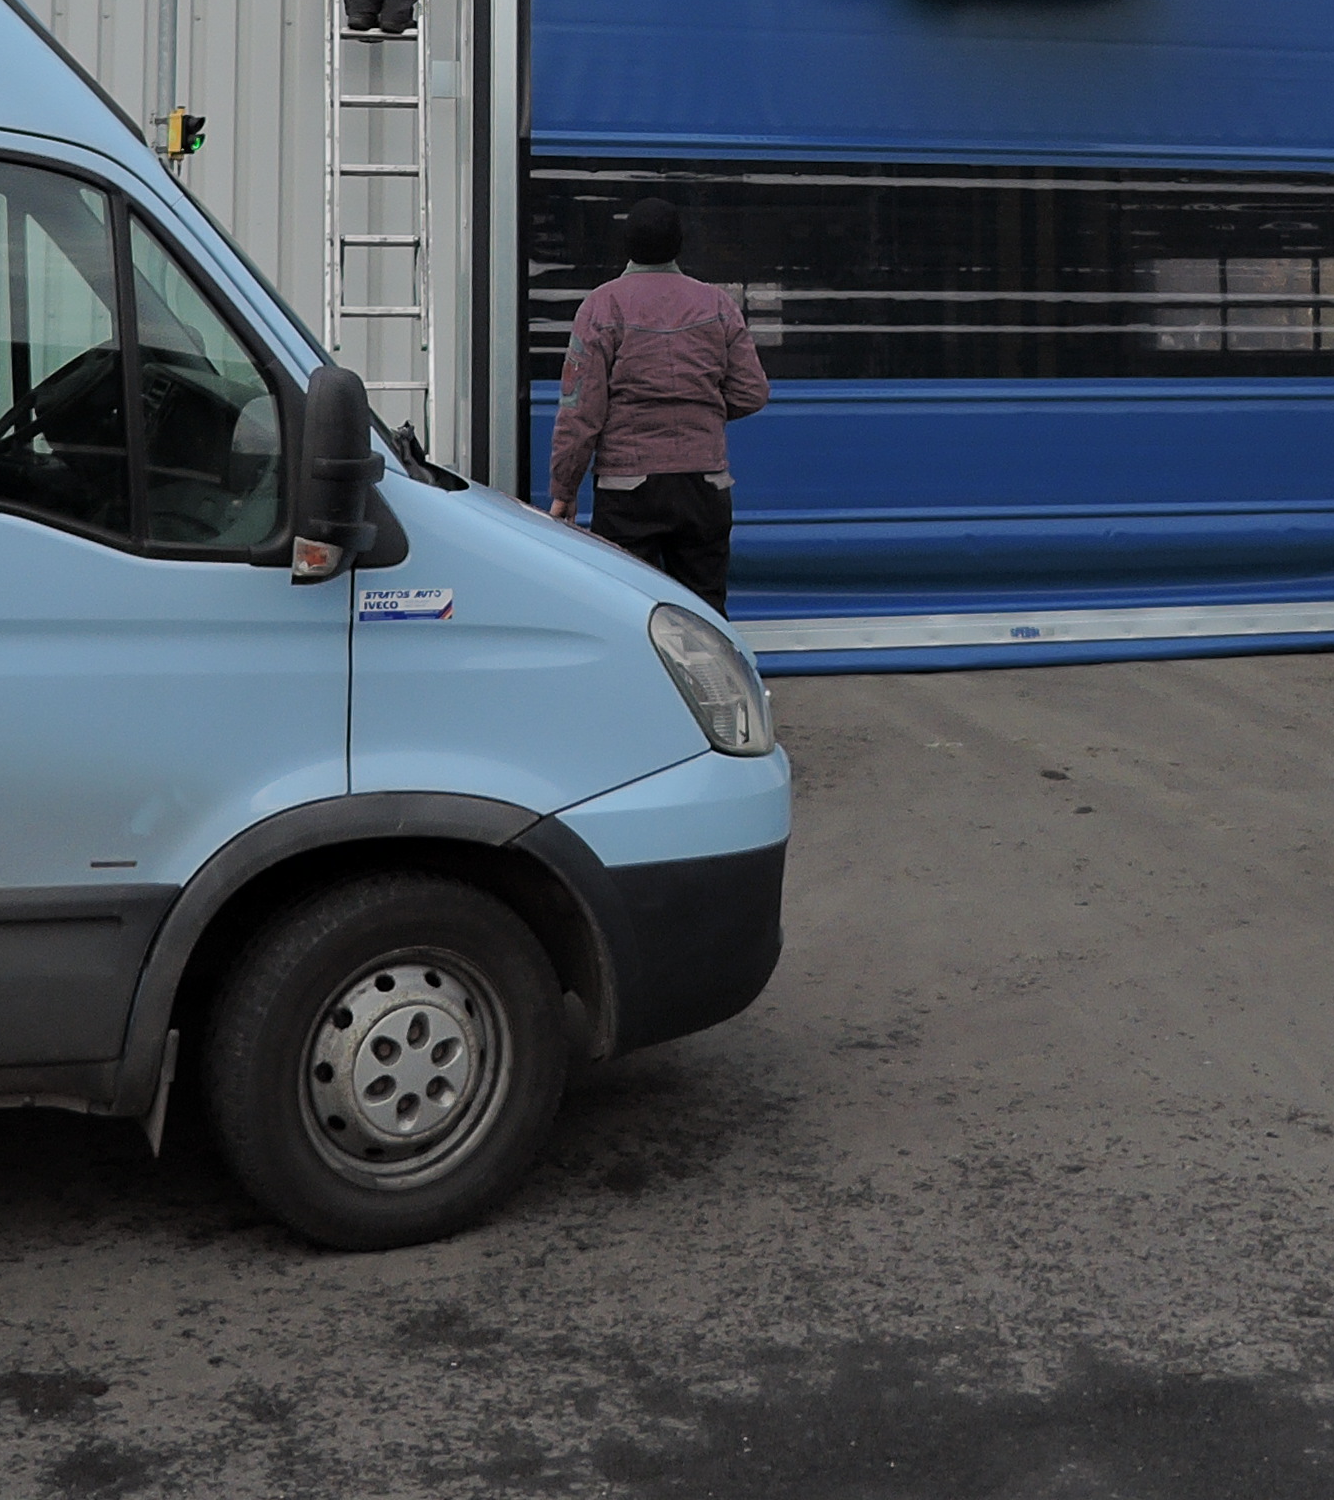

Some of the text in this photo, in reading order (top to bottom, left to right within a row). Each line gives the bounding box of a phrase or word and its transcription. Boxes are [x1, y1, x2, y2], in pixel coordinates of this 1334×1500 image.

[364, 590, 441, 599] STRATOS AUTO
[364, 601, 398, 610] IVECO
